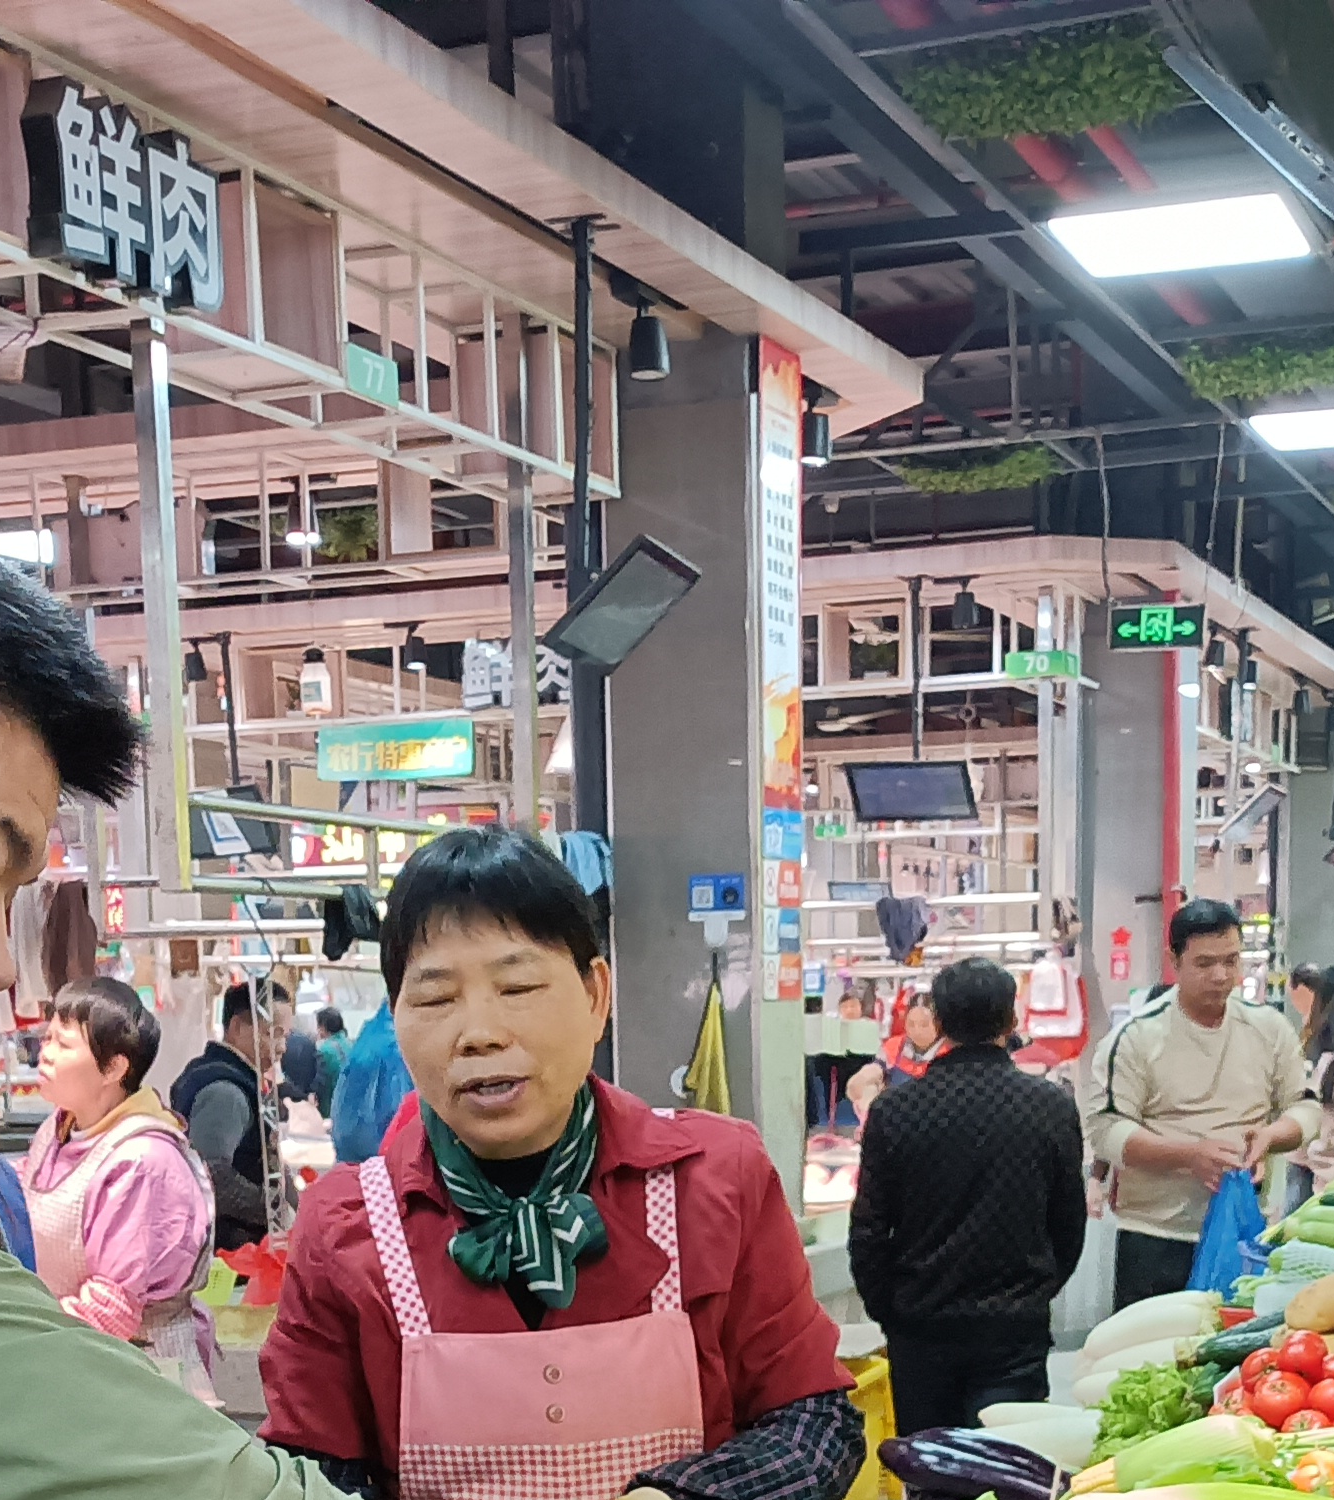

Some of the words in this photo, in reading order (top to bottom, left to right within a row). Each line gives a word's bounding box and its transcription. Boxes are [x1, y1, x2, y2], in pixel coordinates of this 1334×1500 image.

[56, 85, 221, 311] 鲜肉
[362, 356, 385, 394] 77
[1023, 654, 1050, 674] 70
